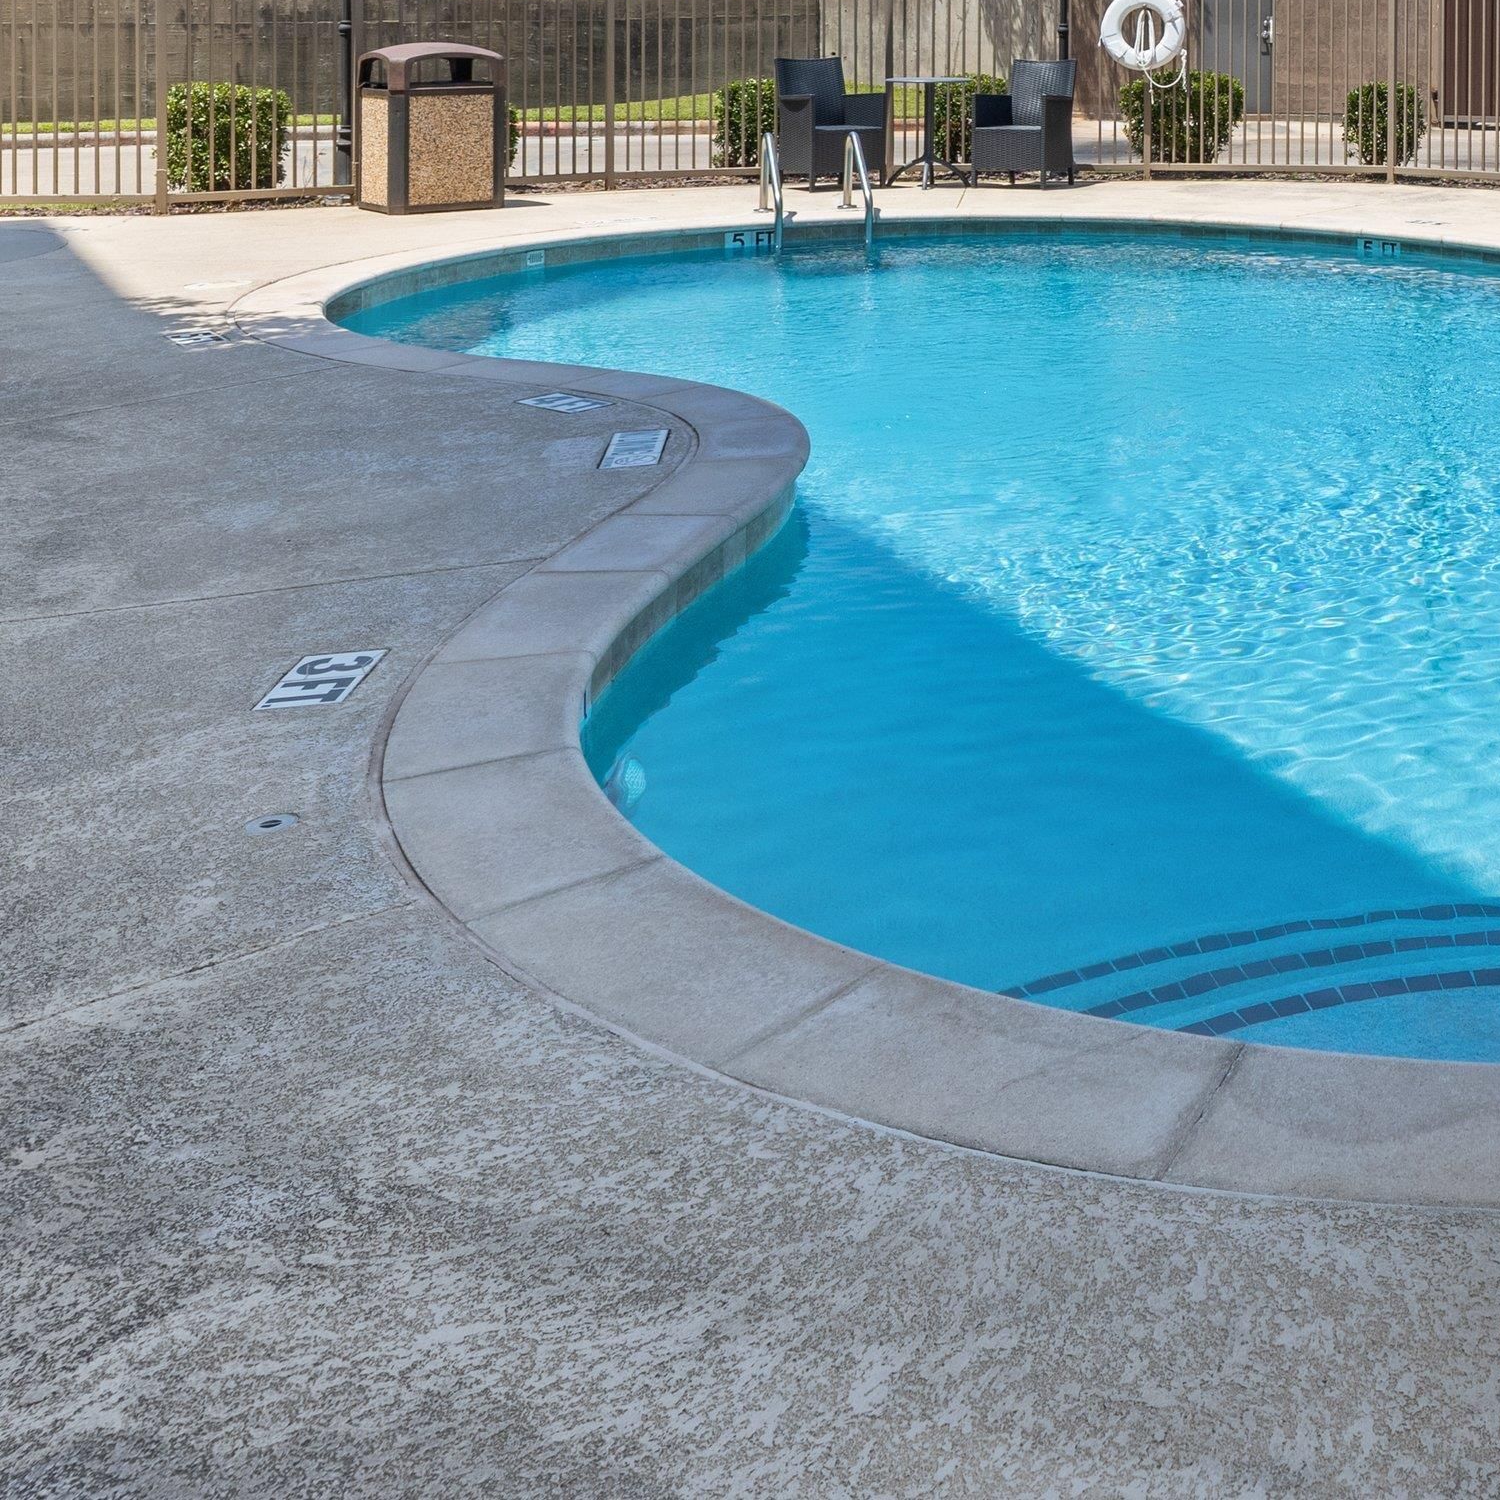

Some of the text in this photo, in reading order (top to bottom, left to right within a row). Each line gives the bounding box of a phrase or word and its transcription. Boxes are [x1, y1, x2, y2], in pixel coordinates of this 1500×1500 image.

[732, 231, 776, 247] 5 FT
[296, 655, 374, 675] 3
